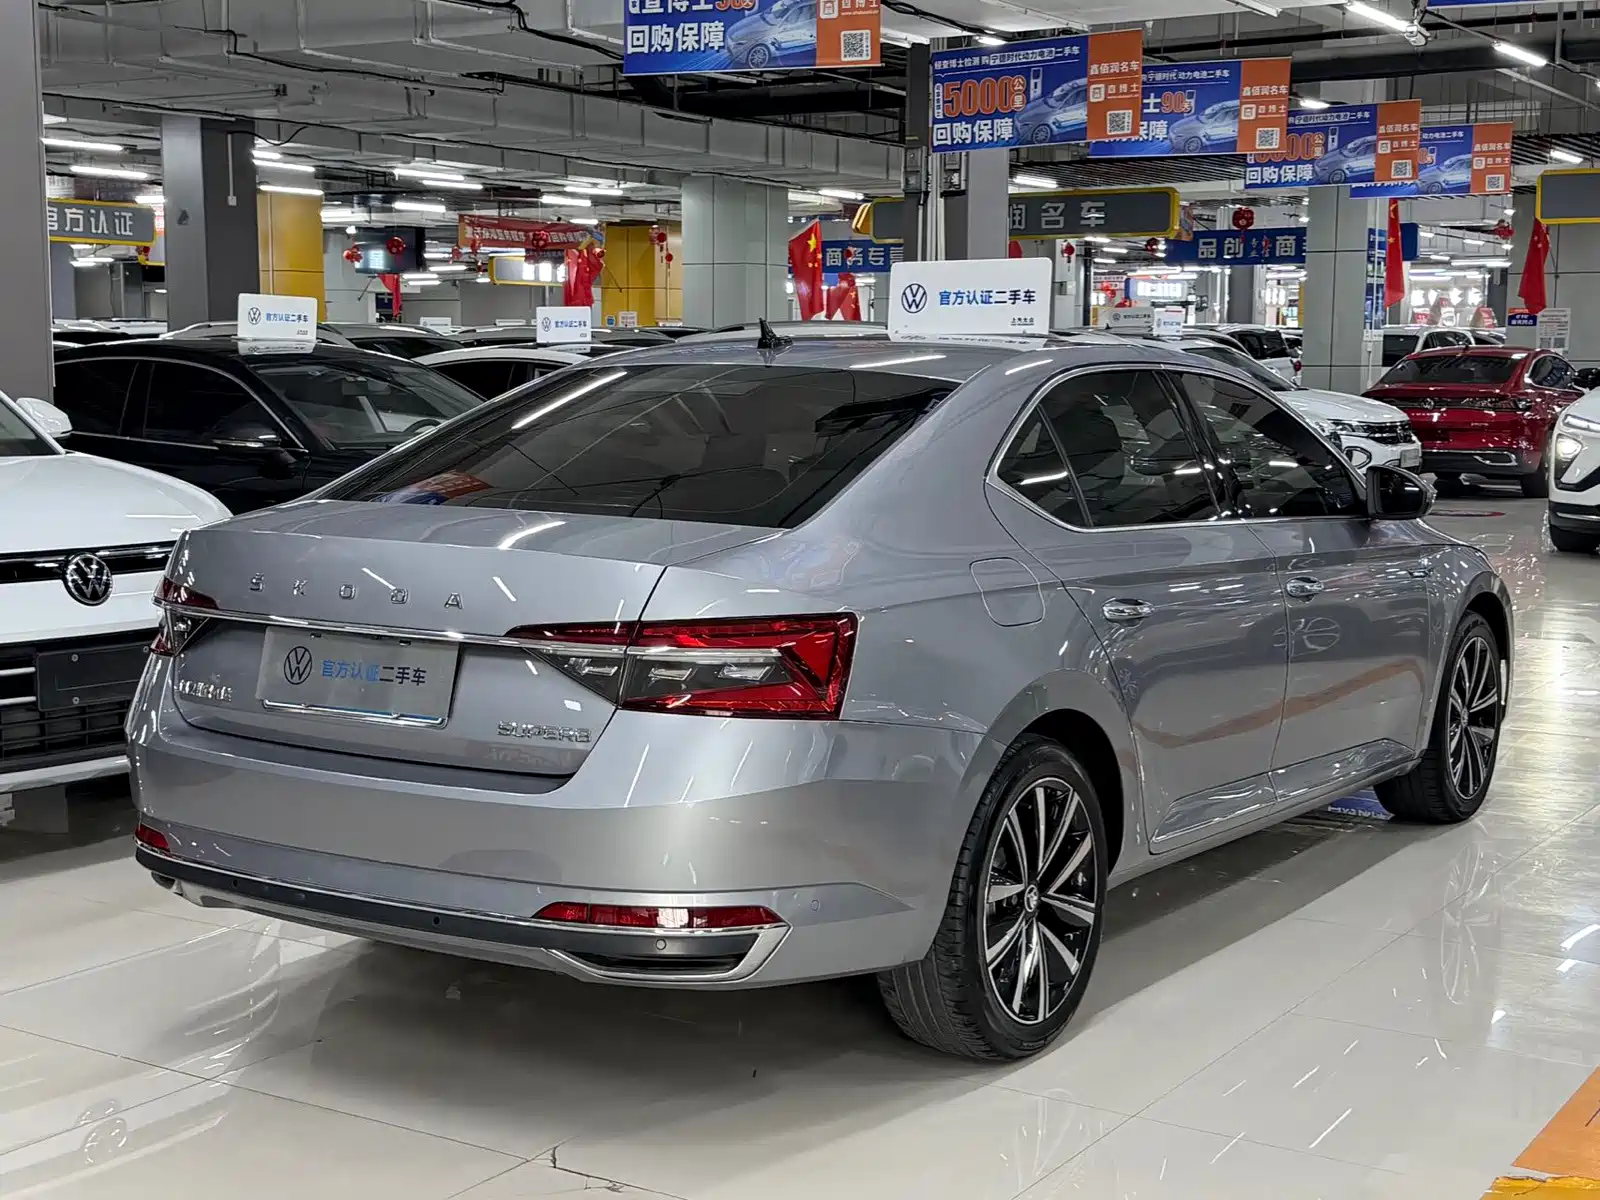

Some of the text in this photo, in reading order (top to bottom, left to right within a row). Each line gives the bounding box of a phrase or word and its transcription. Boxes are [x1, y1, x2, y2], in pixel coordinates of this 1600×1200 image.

[627, 20, 725, 54] 回购保障
[1090, 61, 1140, 75] 鑫佰润名车
[944, 76, 1013, 117] 5000
[933, 118, 1014, 146] 回购保障
[1246, 164, 1314, 184] 回购保障
[1198, 238, 1244, 259] 品创
[1275, 235, 1306, 257] 商
[939, 289, 1036, 306] 官方认证二手车
[321, 659, 427, 687] 官方认证二手车
[498, 720, 592, 743] SUPERB
